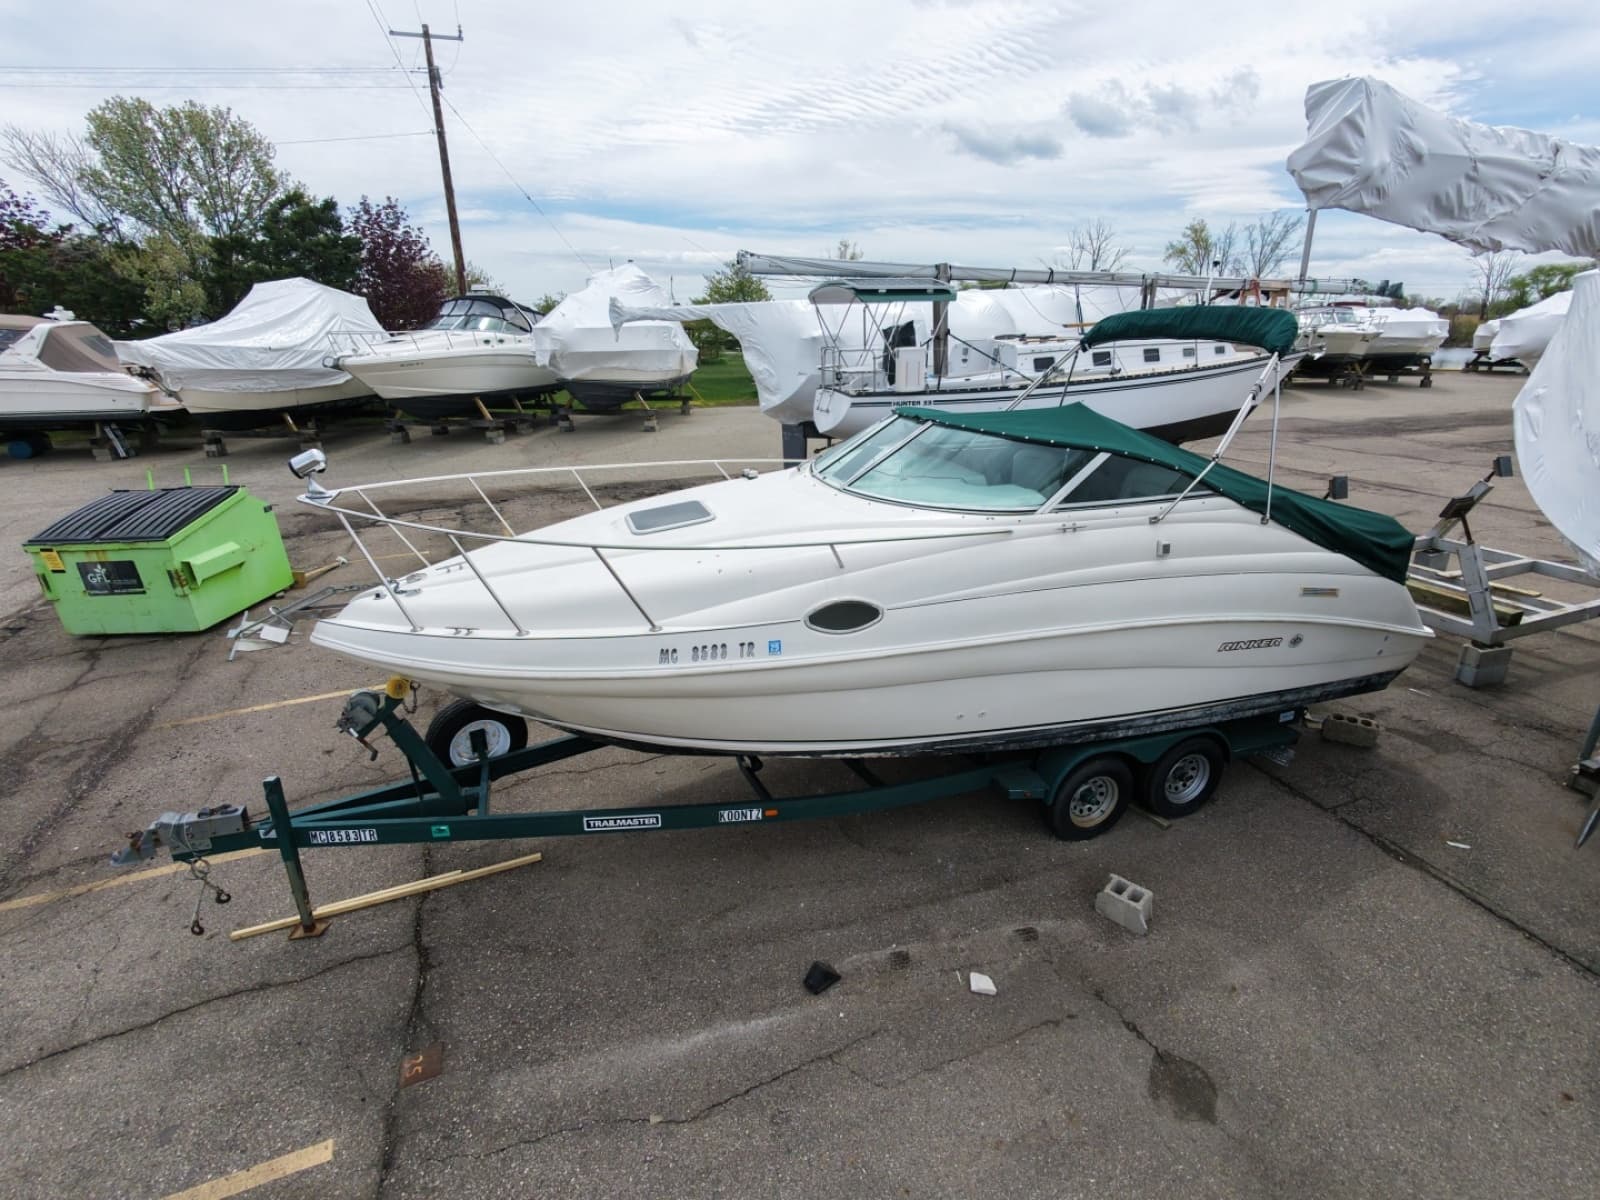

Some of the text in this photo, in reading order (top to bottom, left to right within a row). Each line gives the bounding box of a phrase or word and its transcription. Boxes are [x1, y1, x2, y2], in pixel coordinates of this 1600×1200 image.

[87, 569, 111, 583] GFL
[1217, 637, 1283, 652] RINKER
[659, 648, 678, 664] MC
[739, 642, 755, 658] TR
[588, 817, 657, 828] TRAILMASTER
[719, 809, 762, 822] KOONTZ
